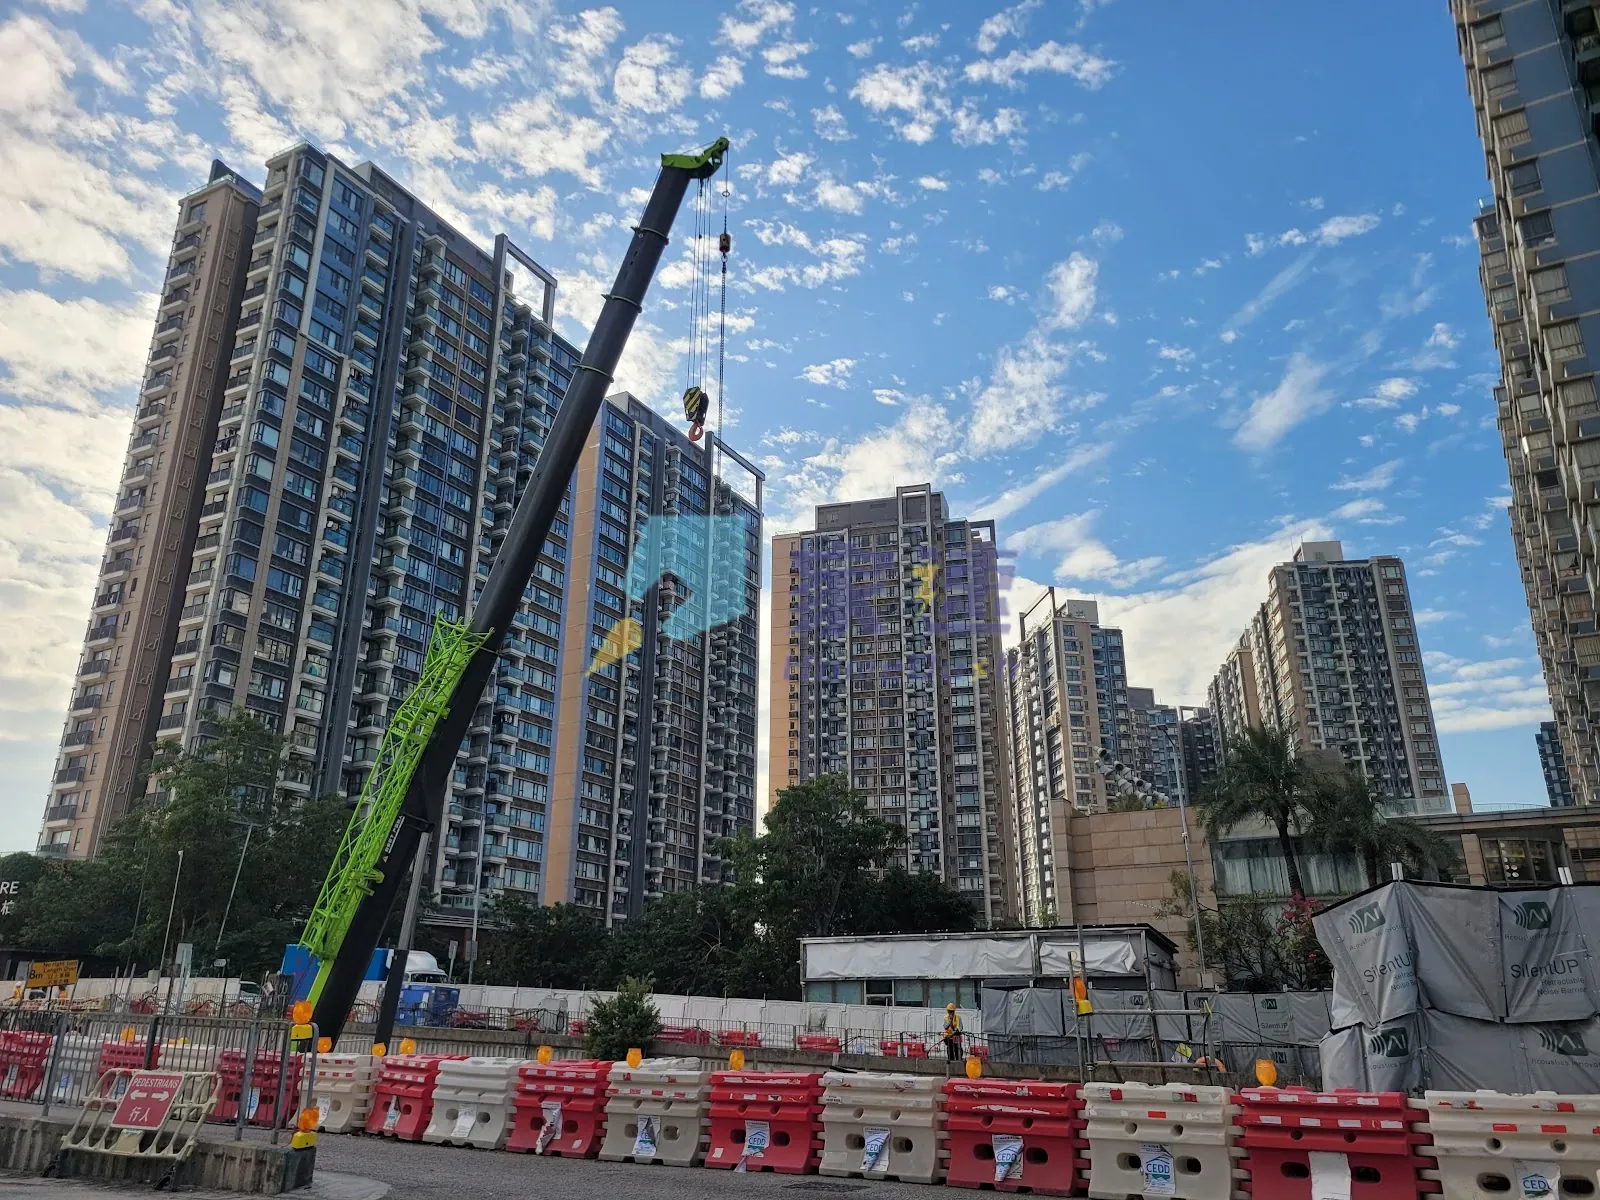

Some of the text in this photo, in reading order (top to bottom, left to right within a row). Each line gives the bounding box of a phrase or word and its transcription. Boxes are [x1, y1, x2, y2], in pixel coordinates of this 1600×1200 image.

[1363, 951, 1412, 983] SilentU
[1510, 958, 1579, 979] SilentUP
[1571, 1059, 1600, 1069] Innova
[132, 1077, 180, 1089] PEDESTRIANS
[128, 1106, 151, 1122] 行人
[1146, 1163, 1171, 1174] CEDD
